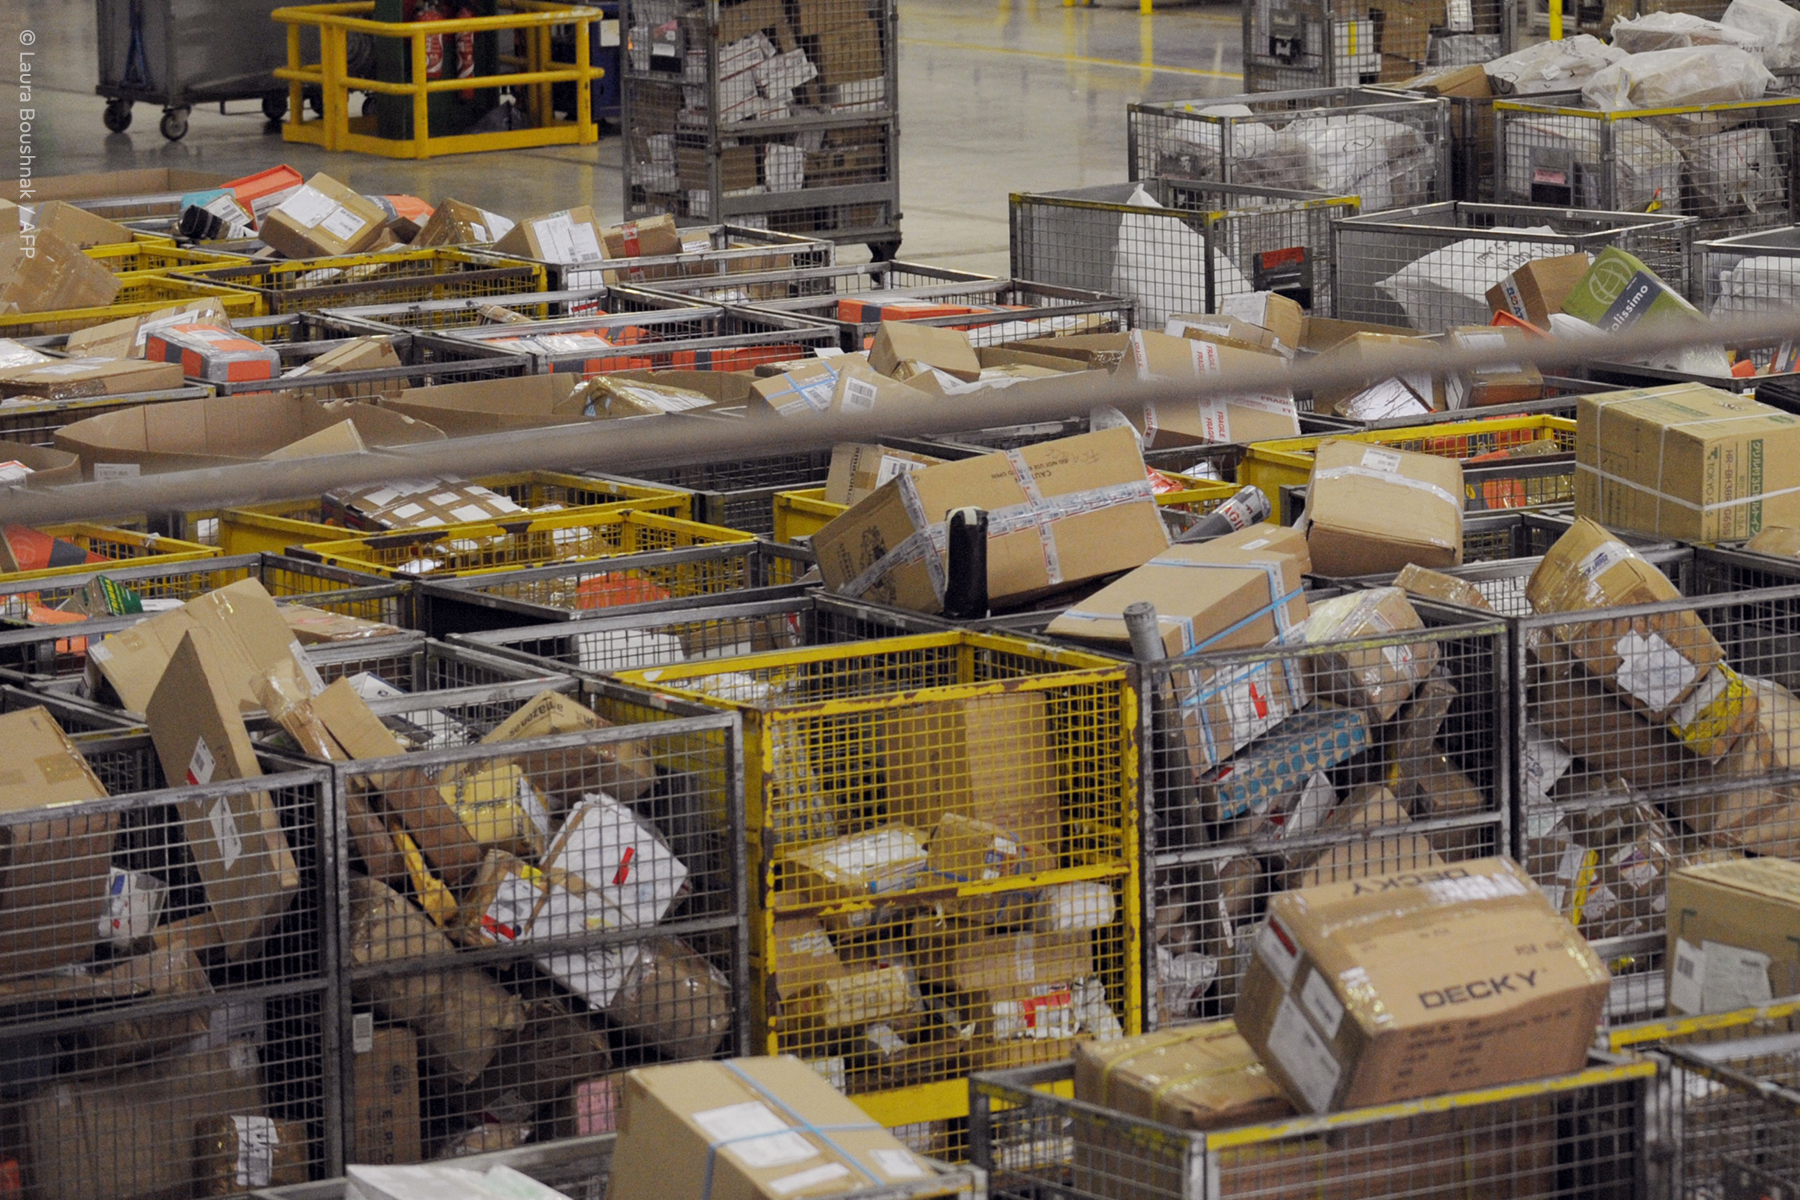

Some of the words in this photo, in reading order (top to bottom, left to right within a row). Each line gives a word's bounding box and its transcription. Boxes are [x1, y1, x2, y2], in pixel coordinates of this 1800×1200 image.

[1216, 411, 1227, 438] FRAGILE
[1706, 462, 1715, 496] TOKYO
[1705, 497, 1714, 518] GS
[1417, 969, 1536, 1009] DECKY
